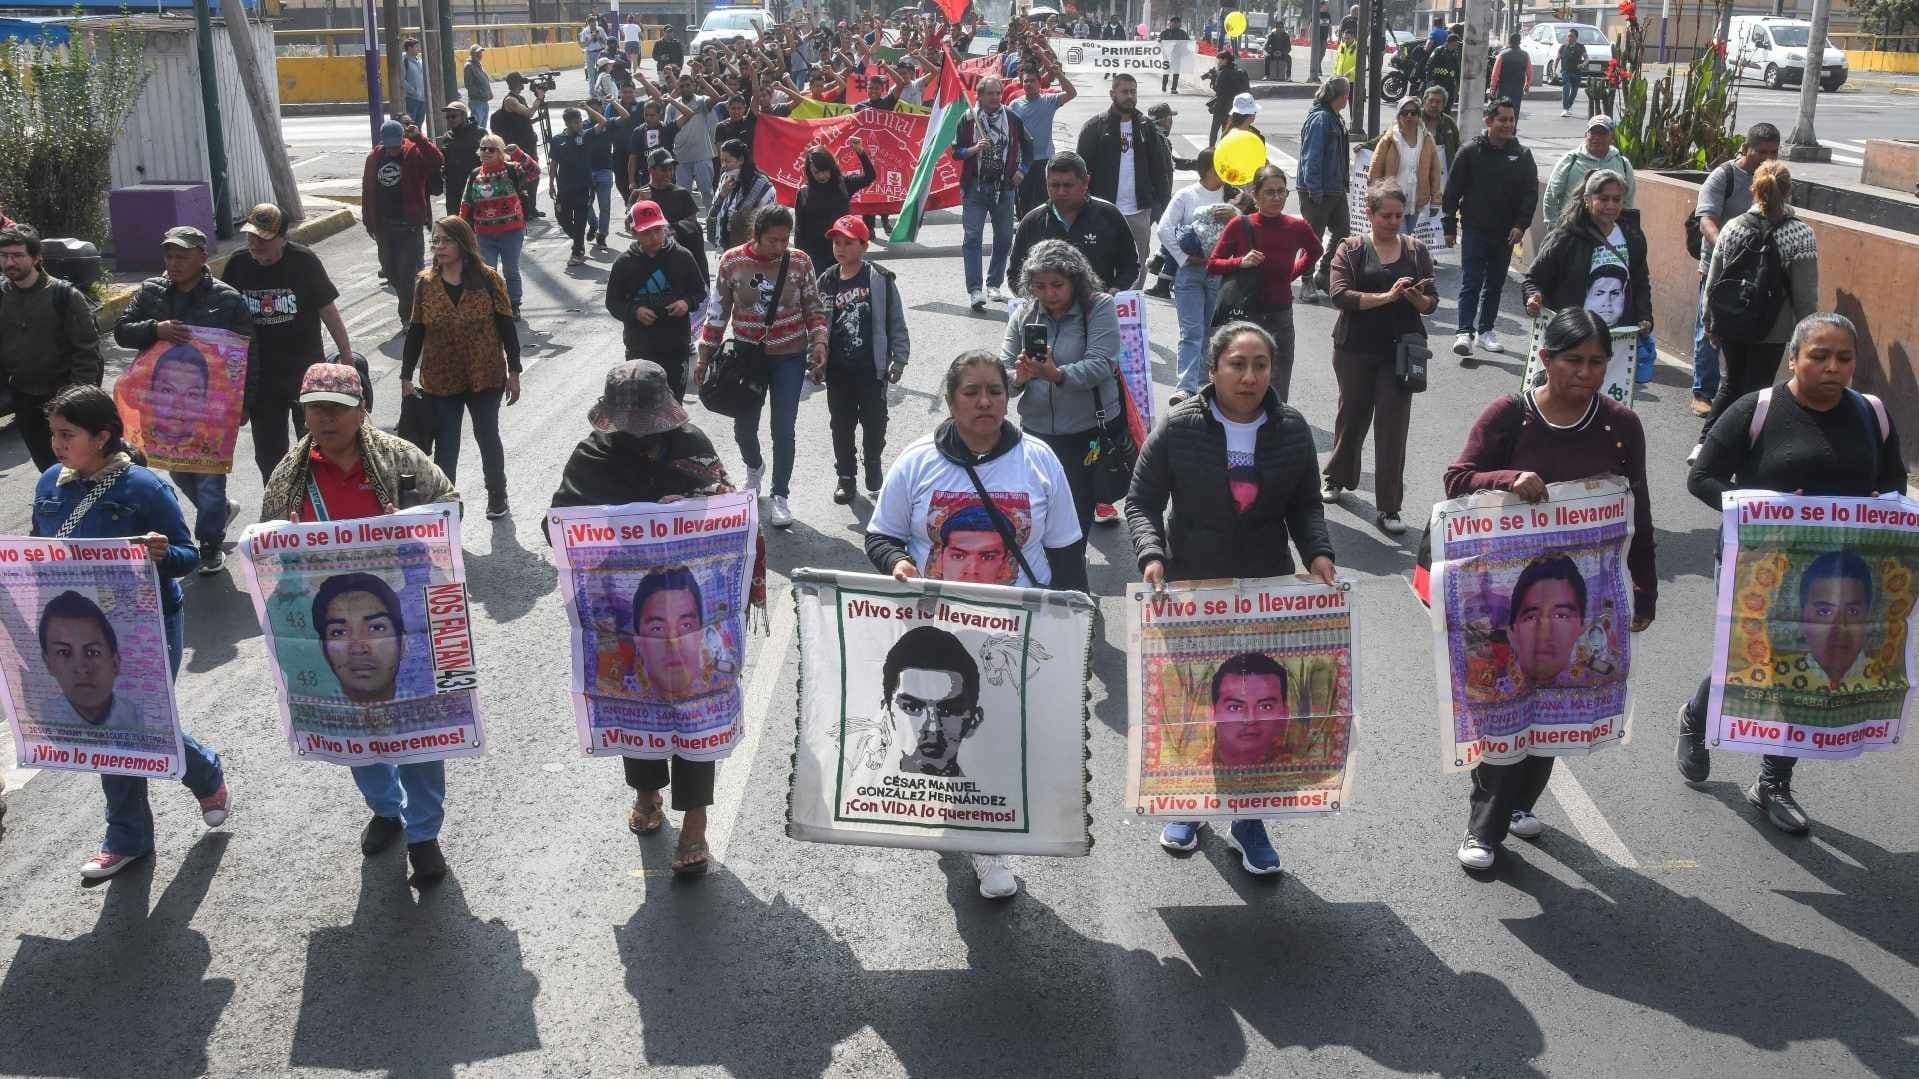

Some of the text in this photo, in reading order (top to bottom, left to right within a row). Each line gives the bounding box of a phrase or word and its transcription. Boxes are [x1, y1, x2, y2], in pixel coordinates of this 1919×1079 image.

[1094, 58, 1170, 70] LOS FOLIOS
[1101, 46, 1161, 56] PRIMERO
[1607, 382, 1623, 402] 43
[1447, 497, 1625, 542] ¡Vivo se lo llevaron!
[1742, 501, 1919, 527] ¡Vivo se lo llevaro
[253, 530, 300, 554] ¡Vivo
[306, 531, 329, 546] se
[335, 525, 353, 544] lo
[358, 518, 445, 543] llevaron!
[567, 509, 747, 547] ¡Vivo se lo llevaron!
[23, 548, 45, 562] se
[48, 543, 66, 561] lo
[69, 543, 148, 562] llevaron!
[429, 583, 465, 615] NOS
[1145, 591, 1345, 623] ¡Vivo se lo llevaron!
[847, 599, 891, 619] ¡Vivo
[895, 604, 913, 620] se
[938, 603, 1020, 632] llevaron!
[432, 617, 471, 671] FALTAN
[307, 727, 466, 755] ¡Vivo lo queremos!
[602, 728, 644, 748] ¡Vivo
[648, 733, 666, 748] lo
[1730, 719, 1781, 739] ¡Vivo
[1786, 725, 1805, 742] lo
[31, 744, 169, 772] ¡Vivo lo queremos!
[1467, 735, 1509, 763] ¡Vivo
[1514, 735, 1526, 751] lo
[857, 786, 1007, 807] GONZÁLEZ HERNÁNDEZ
[883, 775, 981, 793] CÉSAR MANUEL
[845, 798, 1016, 823] ¡Con VIDA lo queremos!
[1148, 791, 1328, 815] ¡Vivo lo queremos!
